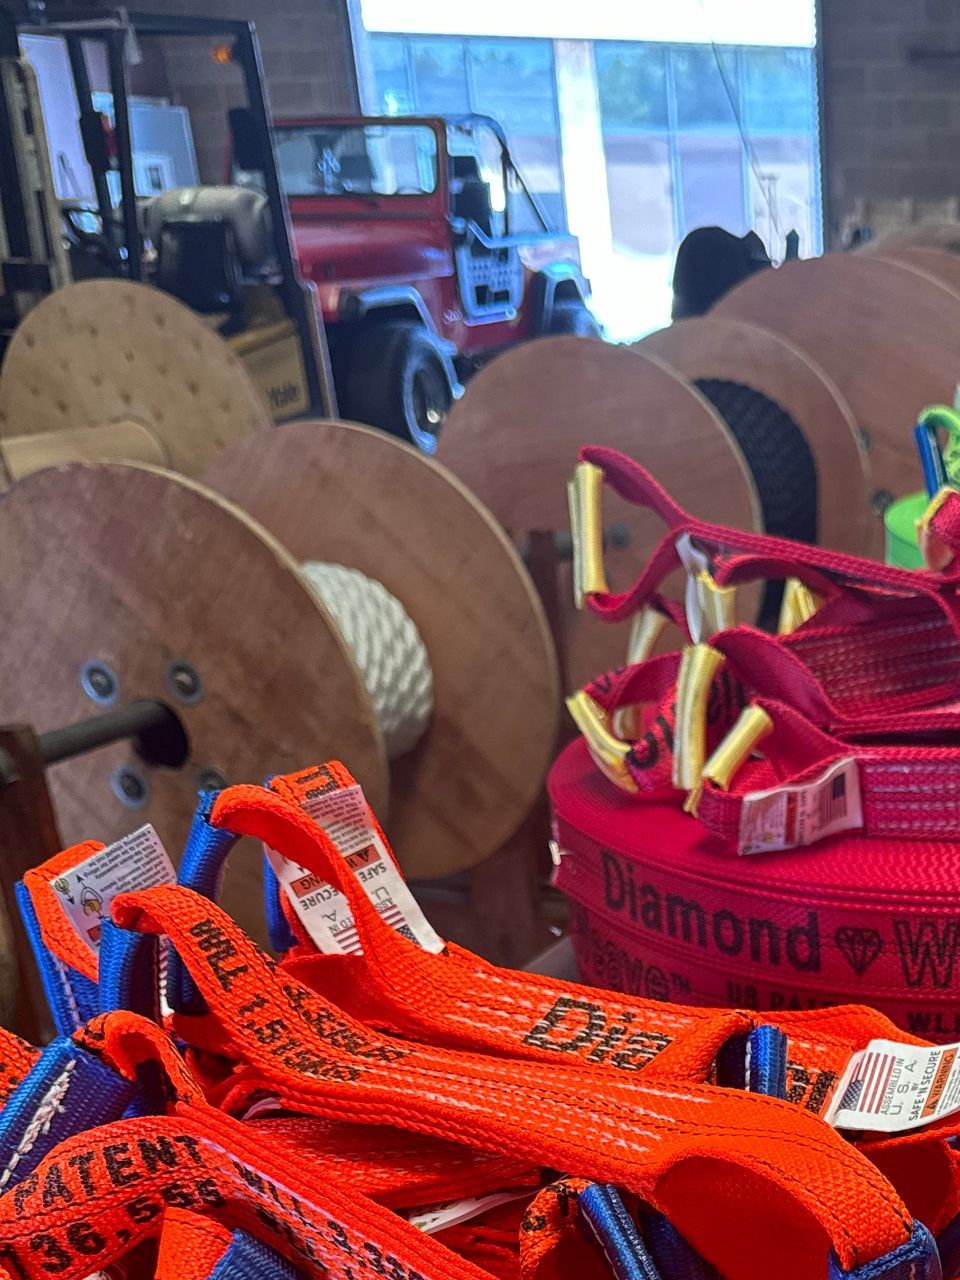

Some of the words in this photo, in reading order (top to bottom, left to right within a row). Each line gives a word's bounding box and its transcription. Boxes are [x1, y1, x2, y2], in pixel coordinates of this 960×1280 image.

[359, 862, 387, 882] SAFE
[602, 853, 819, 974] Diamond
[189, 917, 249, 991] WLL
[880, 1074, 900, 1116] ASSEMBLED
[894, 1058, 906, 1074] IN
[908, 1094, 926, 1121] SAFE
[925, 1050, 942, 1082] SECURE
[910, 1082, 920, 1092] BY
[933, 1052, 954, 1096] WARNING
[14, 1134, 207, 1216] PATENT
